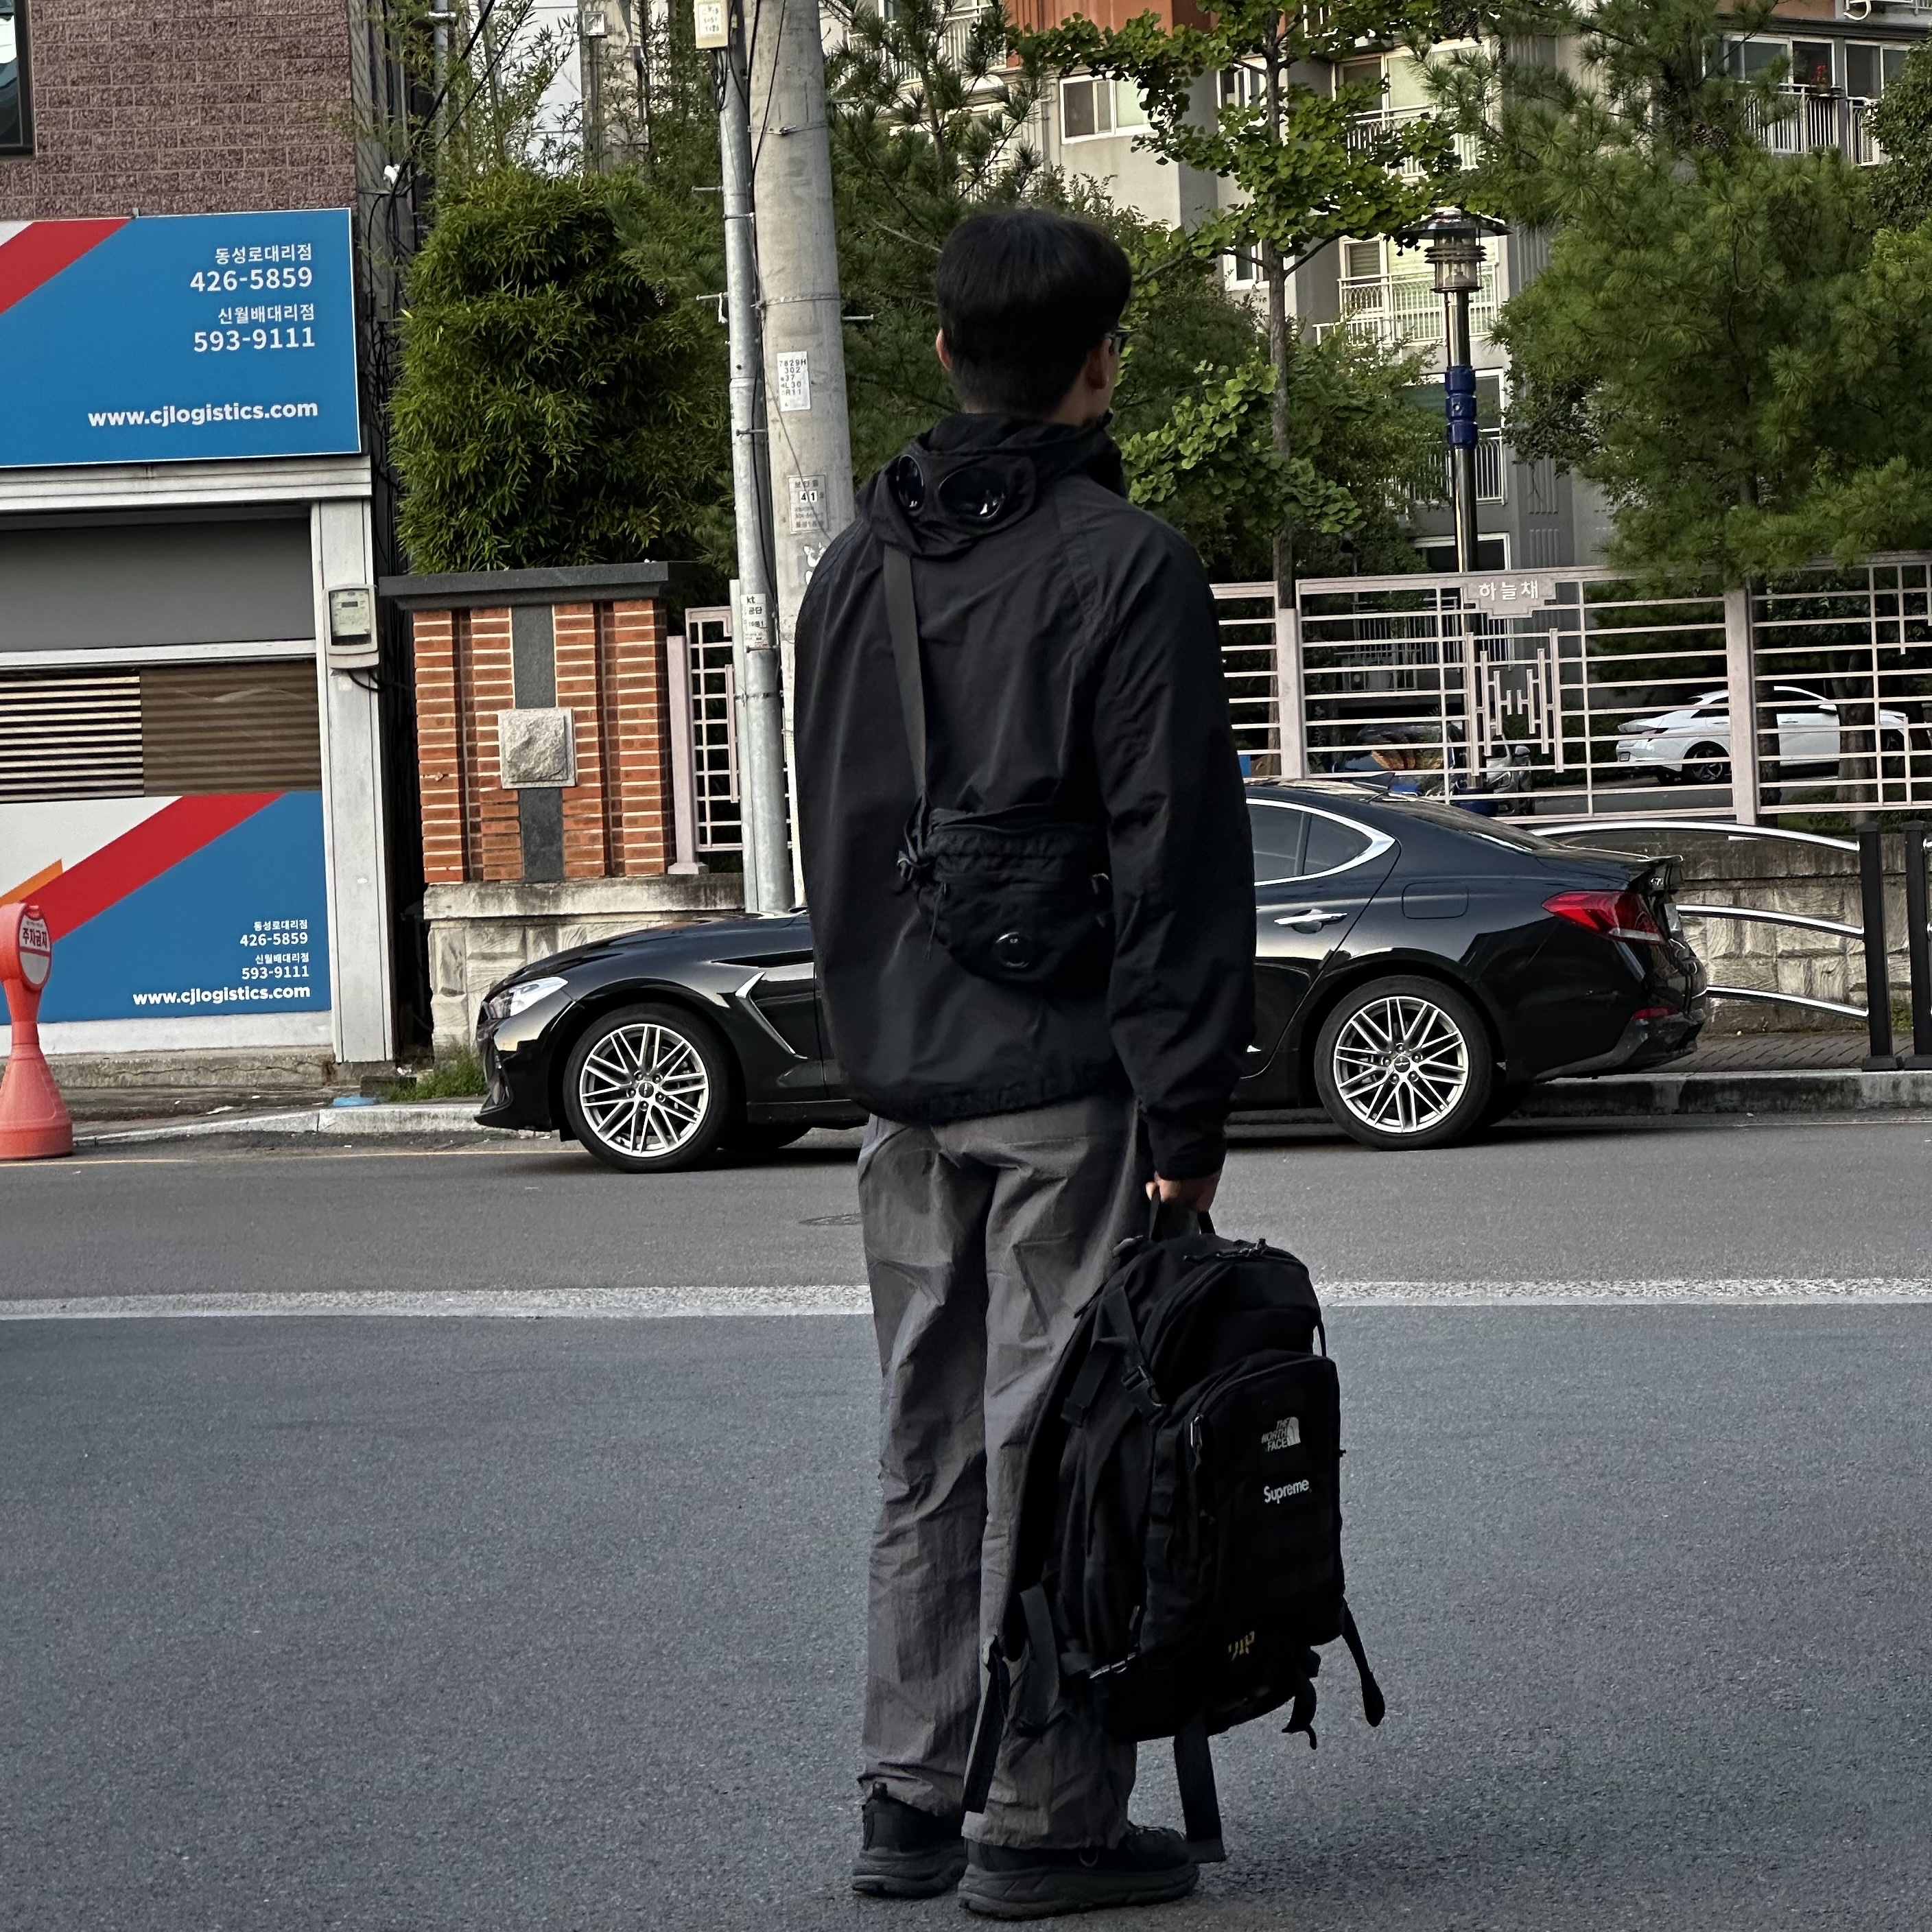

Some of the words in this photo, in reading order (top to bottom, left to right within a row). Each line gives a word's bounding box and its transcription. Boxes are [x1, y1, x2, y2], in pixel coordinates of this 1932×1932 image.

[215, 243, 313, 265] 동성로대리점
[190, 266, 314, 292] 426-5859
[217, 303, 315, 325] 신월배대리점
[193, 327, 316, 353] 593-9111
[87, 401, 318, 428] www.cjlogistics.com
[801, 492, 816, 502] 41
[746, 596, 755, 604] kt
[1478, 580, 1538, 601] 하늘채
[253, 919, 309, 932] 동성로대리점
[239, 931, 309, 947] 426-5859
[242, 965, 310, 980] 593-9111
[132, 985, 311, 1006] www.cjlogistics.com
[1267, 1437, 1288, 1452] FACE
[1264, 1479, 1310, 1504] Supreme
